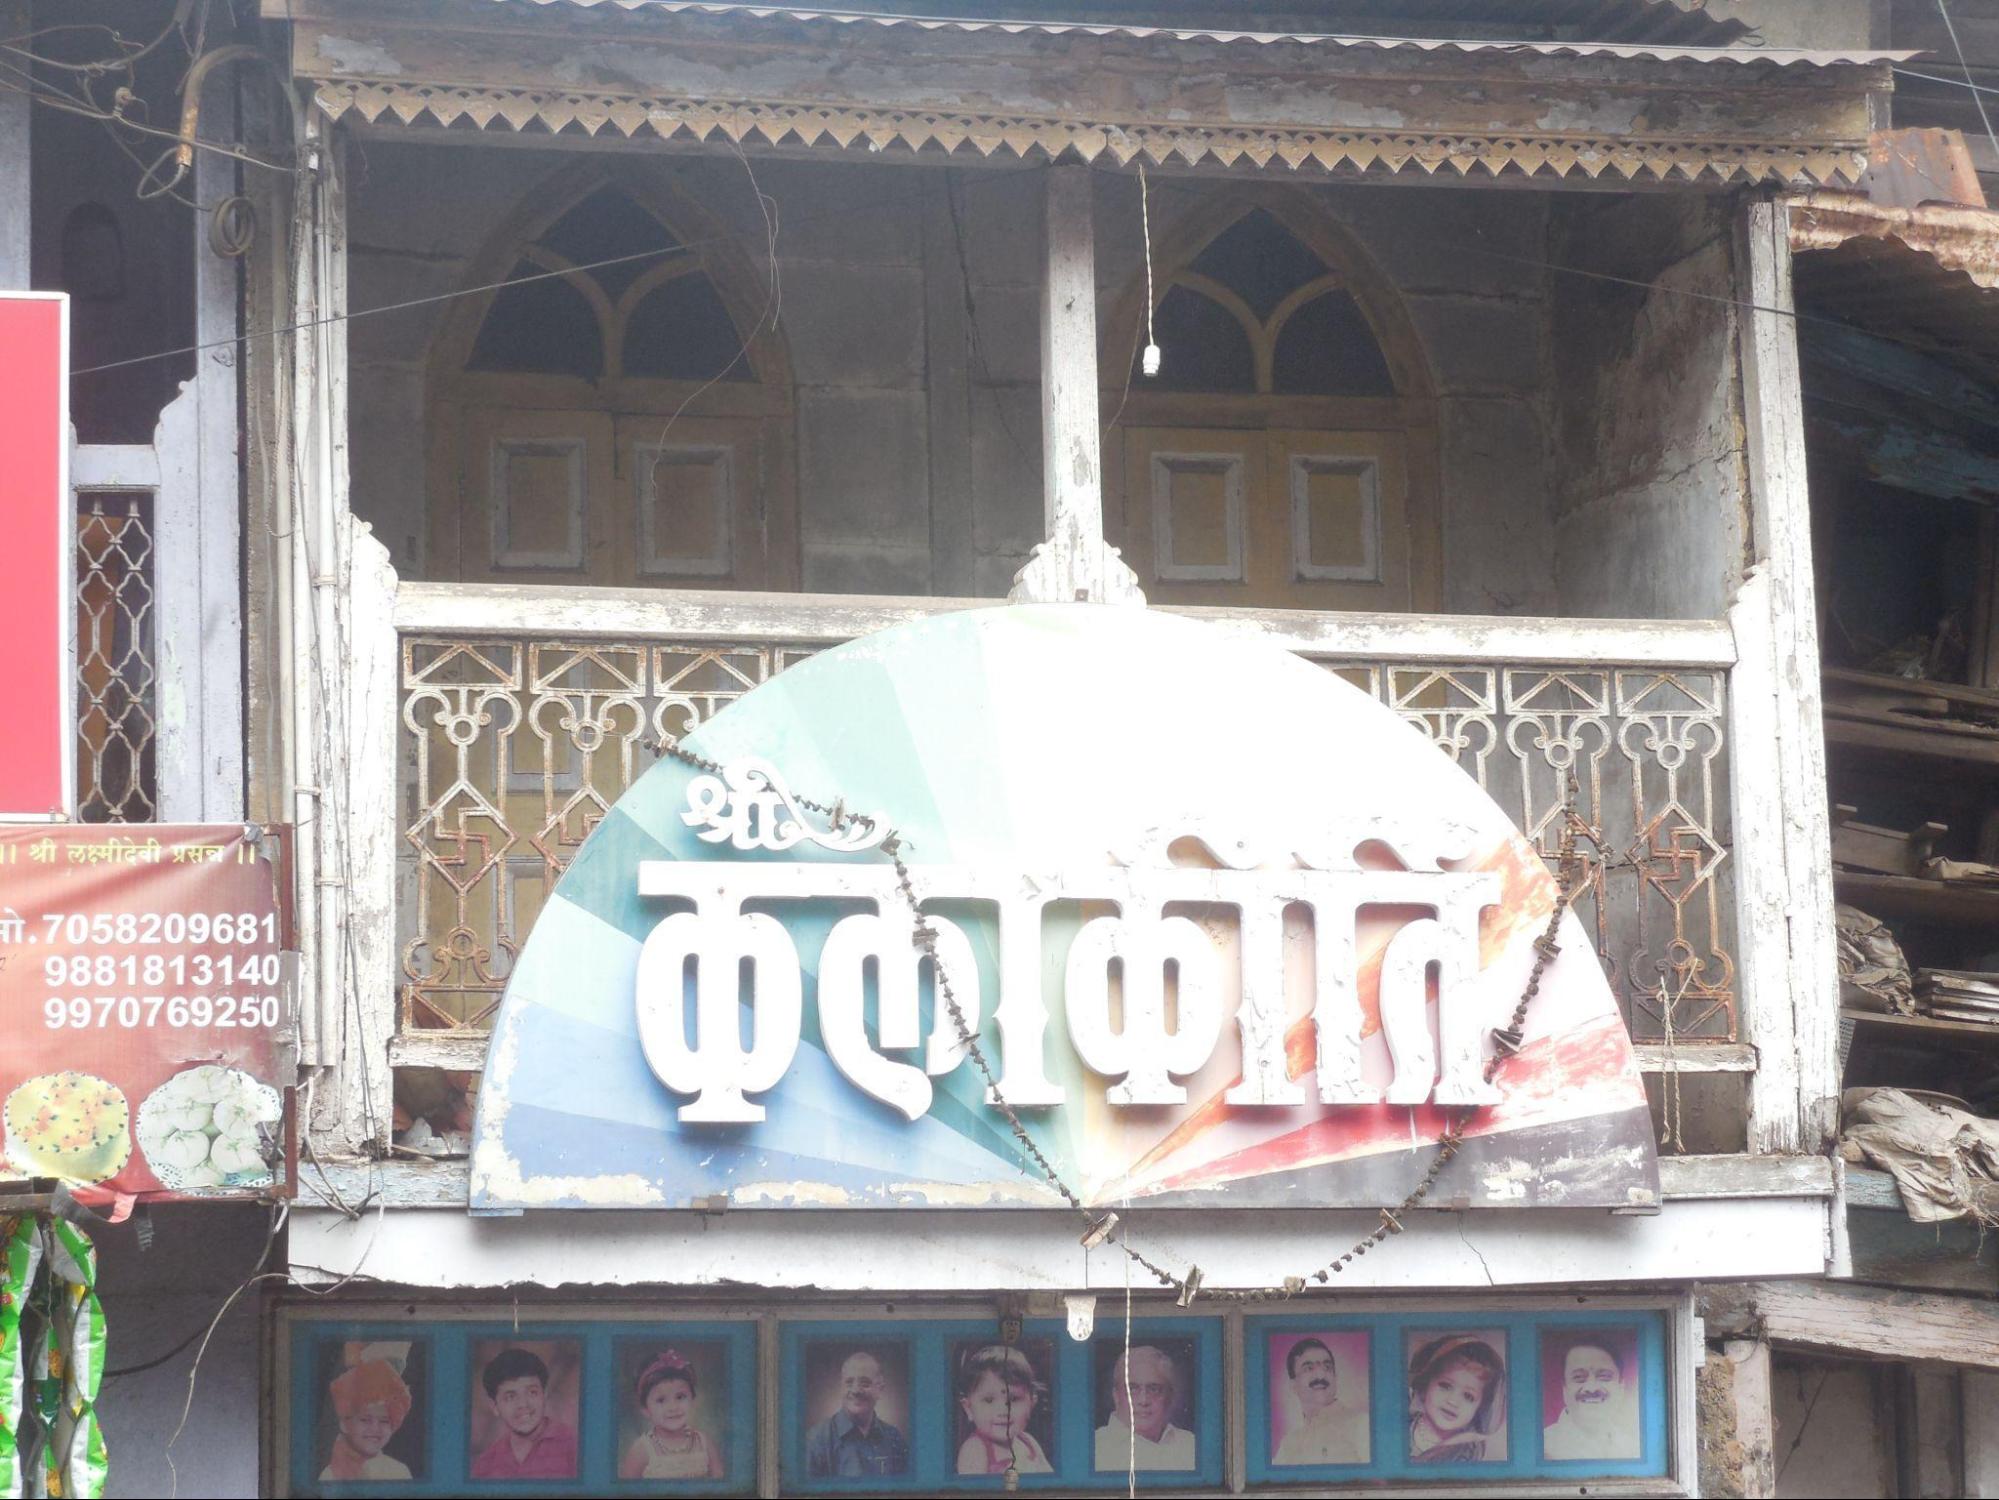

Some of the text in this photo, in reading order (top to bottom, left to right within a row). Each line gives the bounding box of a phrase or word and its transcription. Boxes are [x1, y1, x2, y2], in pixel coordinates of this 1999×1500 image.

[680, 757, 891, 852] श्री
[29, 837, 57, 863] श्री
[66, 836, 162, 866] लक्ष्मीदेवी
[170, 845, 225, 863] प्रसन्न
[45, 954, 280, 987] 9881813140
[44, 996, 279, 1029] 9970769250
